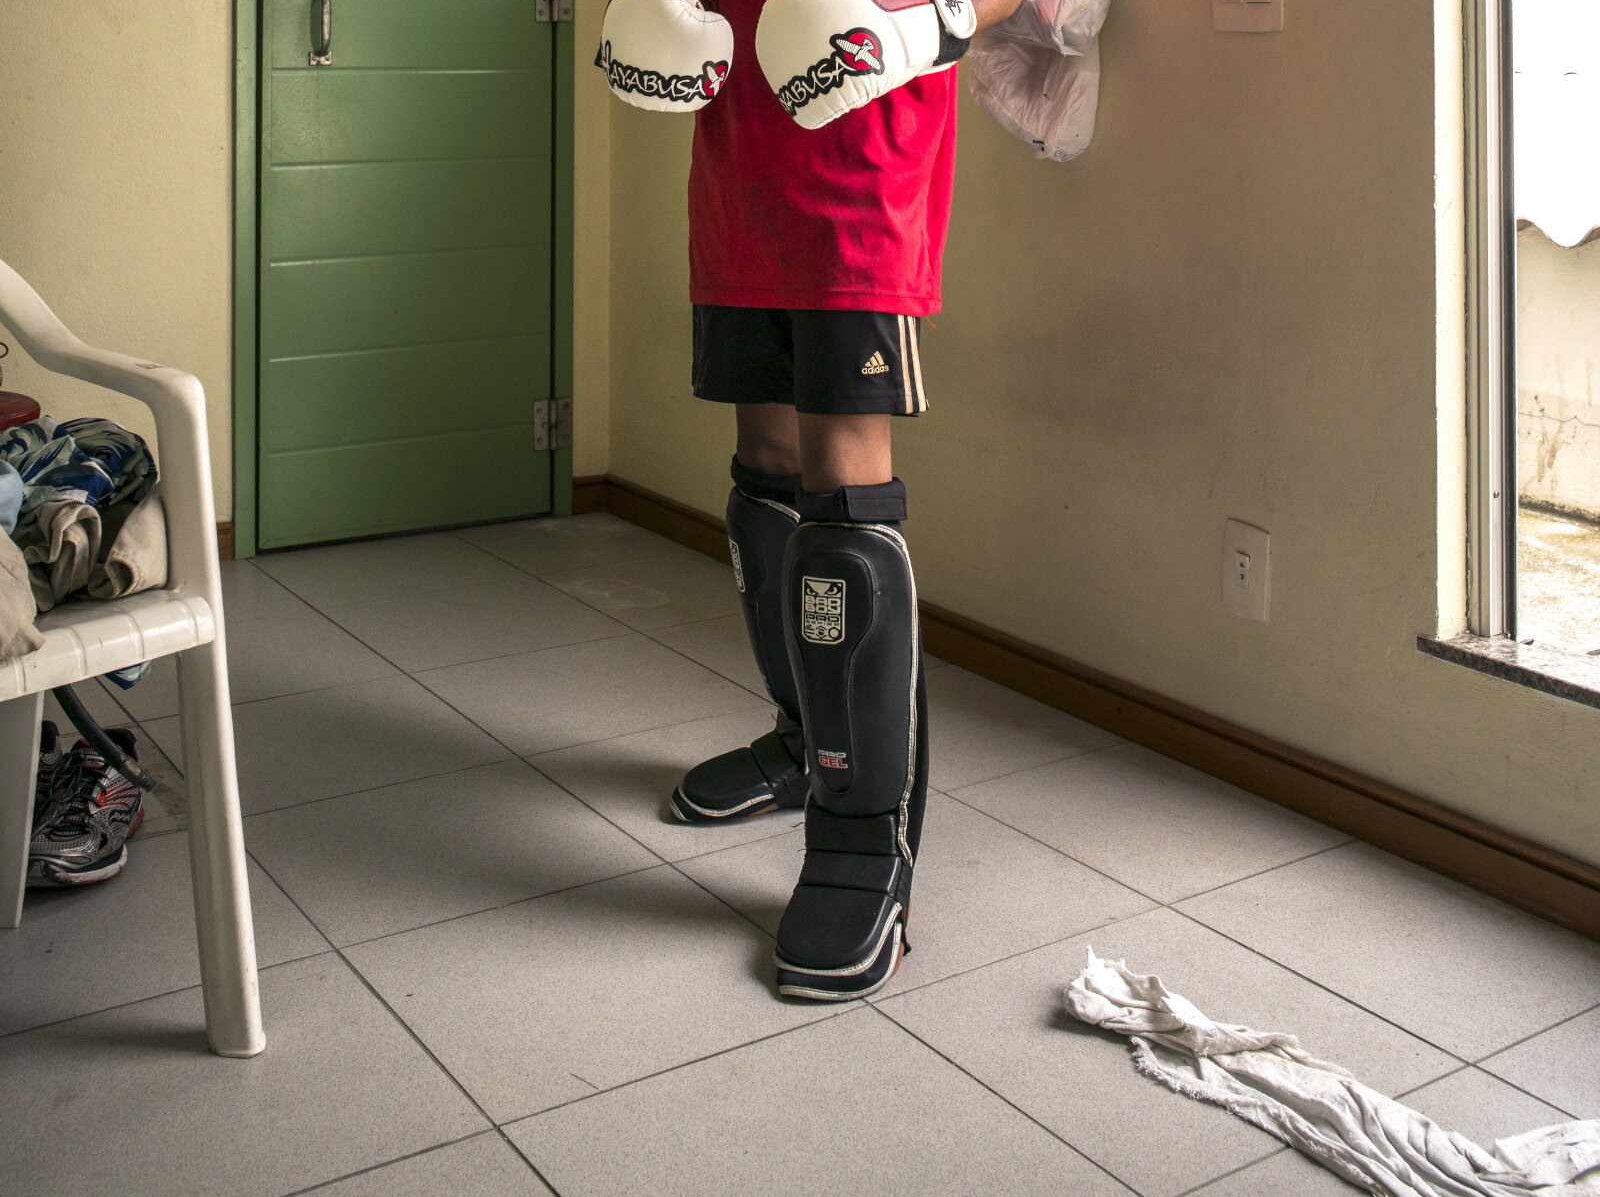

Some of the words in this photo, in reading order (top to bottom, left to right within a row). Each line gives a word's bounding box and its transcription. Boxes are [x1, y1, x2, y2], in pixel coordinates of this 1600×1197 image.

[861, 364, 890, 375] adidas
[805, 595, 841, 607] BAD
[805, 602, 841, 615] BOY
[819, 755, 849, 769] GEL
